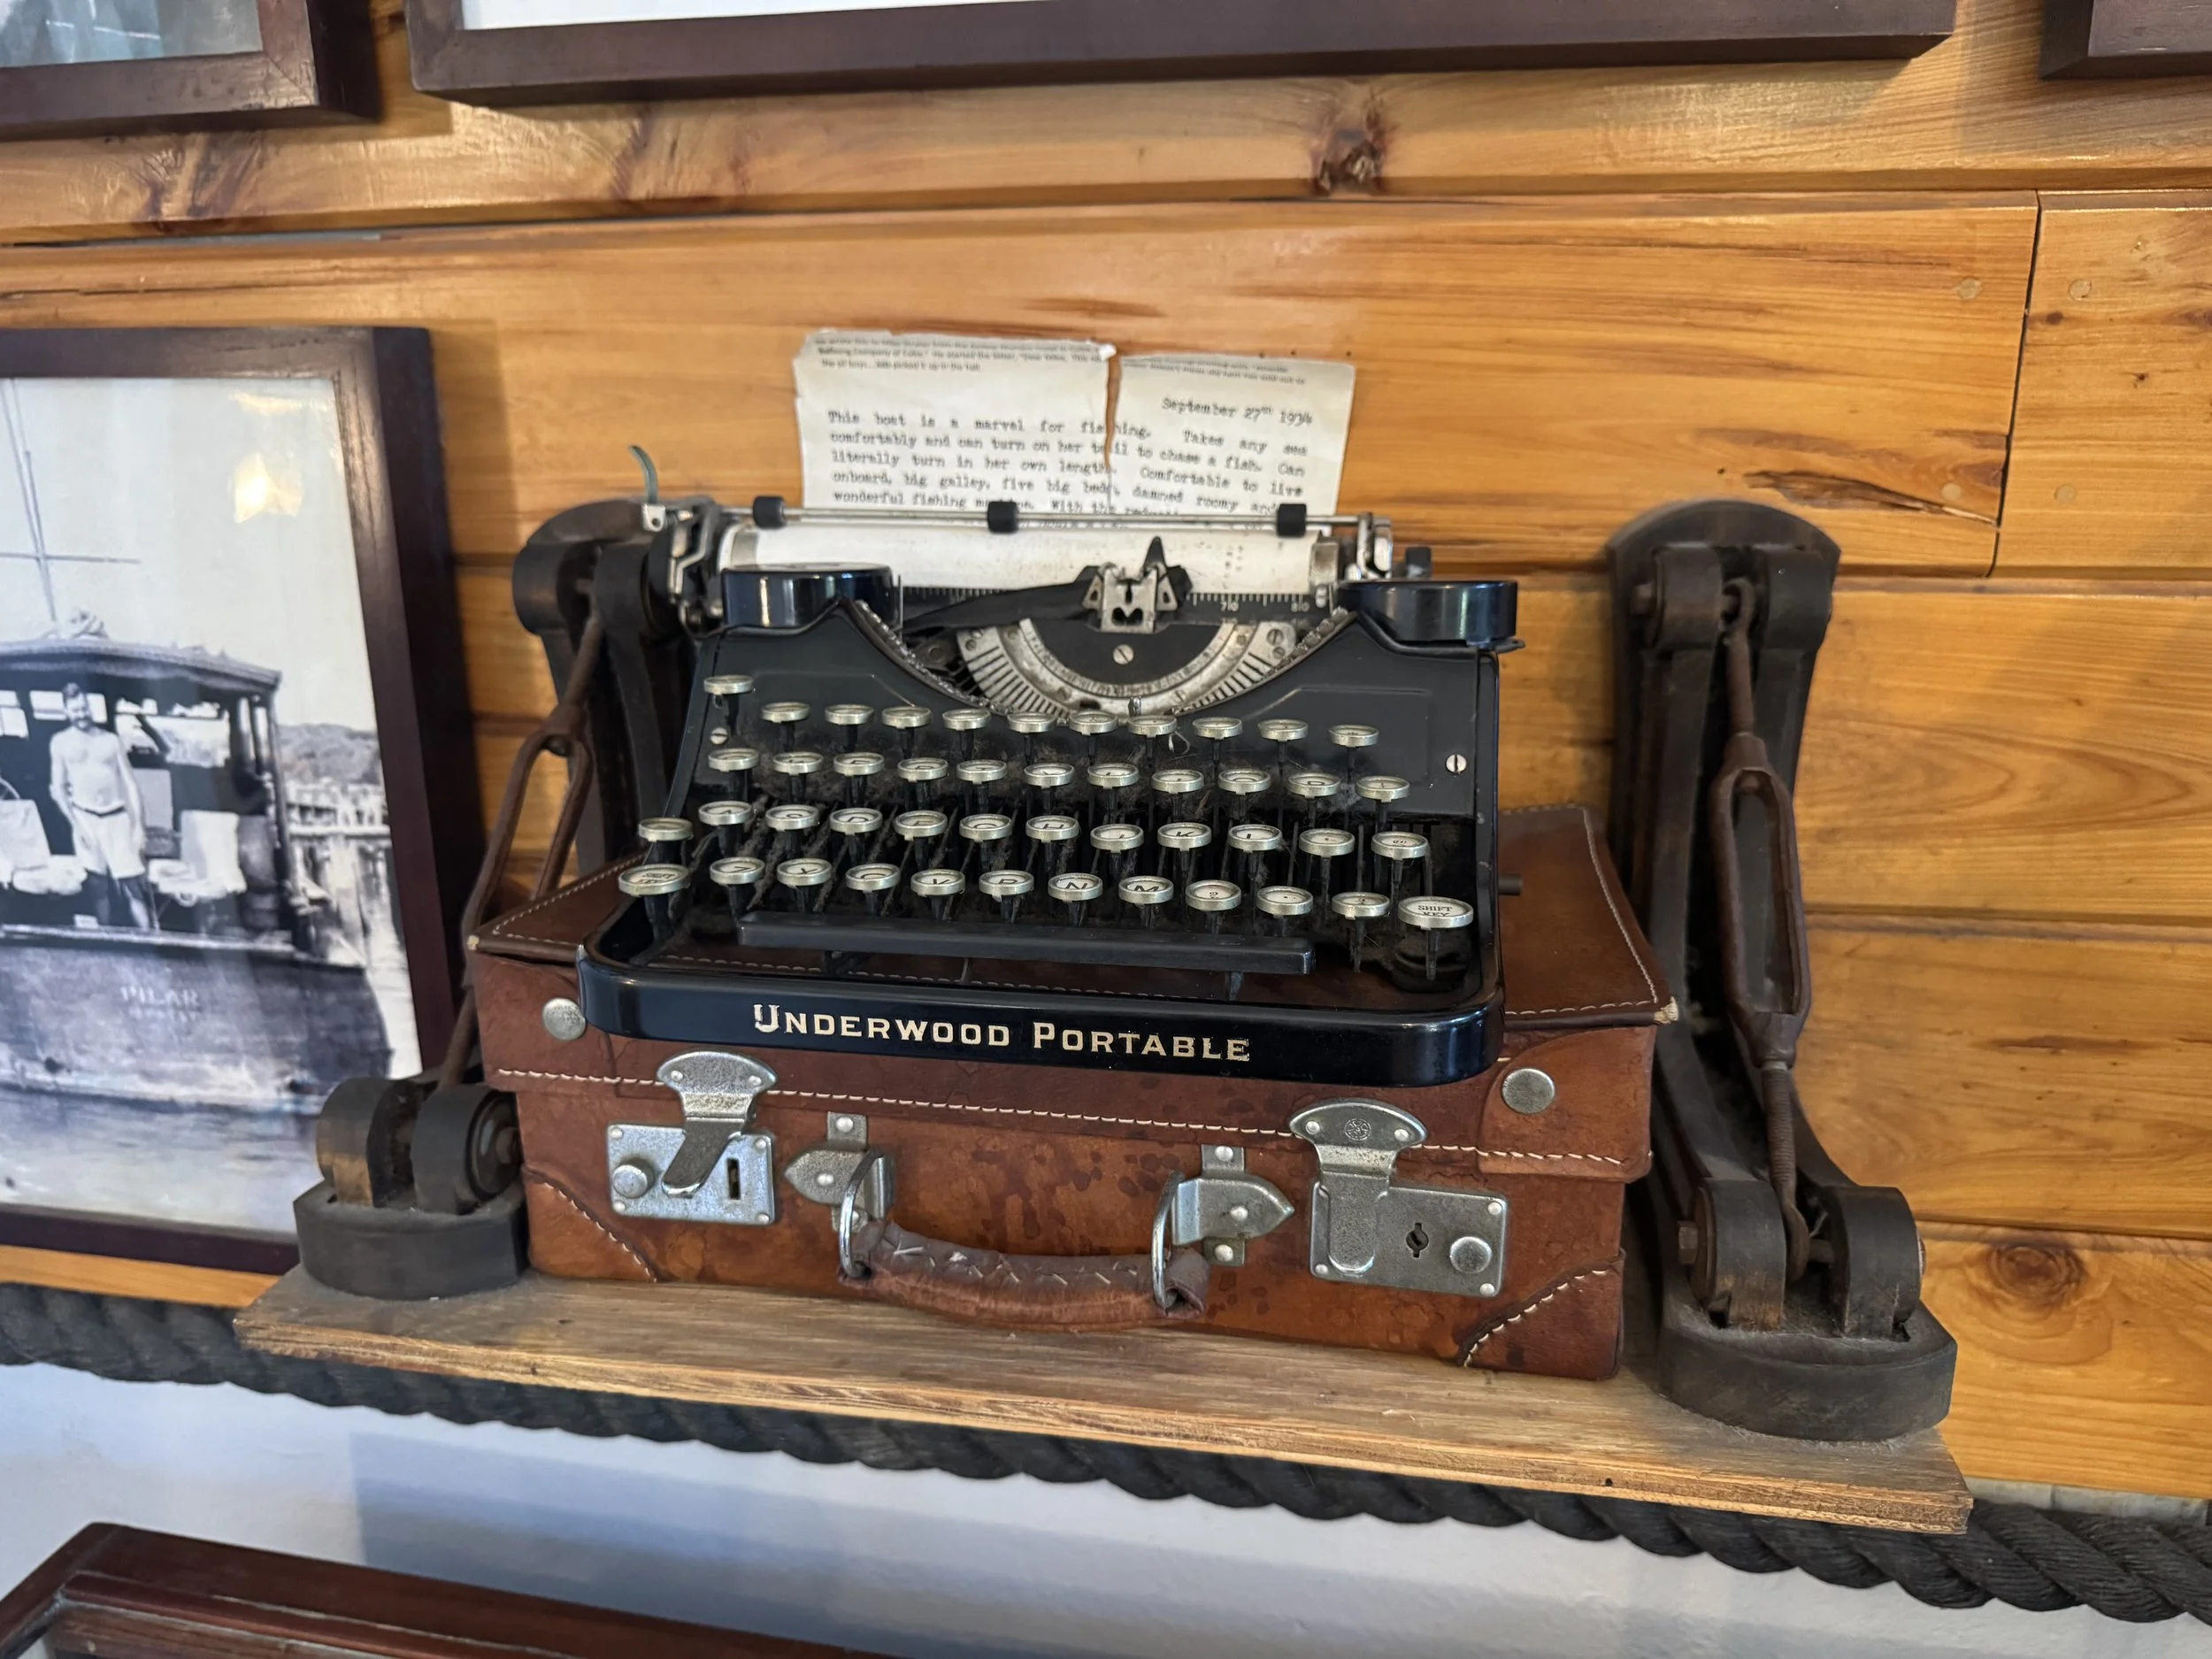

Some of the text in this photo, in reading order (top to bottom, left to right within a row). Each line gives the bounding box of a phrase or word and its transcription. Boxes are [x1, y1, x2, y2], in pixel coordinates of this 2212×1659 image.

[1162, 398, 1236, 419] September
[828, 410, 859, 424] This
[874, 411, 906, 426] boat
[921, 414, 935, 427] is
[950, 418, 959, 428] a
[975, 419, 1025, 432] marvel
[1040, 419, 1065, 433] for
[1182, 429, 1225, 447] Takes
[1239, 440, 1267, 455] any
[1283, 444, 1307, 457] sea
[830, 431, 917, 449] comfortably
[925, 434, 950, 448] and
[958, 438, 983, 449] can
[992, 435, 1025, 451] turn
[1032, 441, 1050, 452] on
[1058, 441, 1083, 454] her
[1137, 444, 1153, 458] to
[1159, 449, 1201, 465] chase
[1207, 456, 1217, 466] a
[1278, 463, 1305, 478] Can
[832, 449, 900, 467] literally
[911, 454, 945, 467] turn
[956, 455, 973, 469] in
[984, 457, 1010, 471] her
[1020, 461, 1047, 472] own
[1140, 466, 1231, 489] Comfortable
[1242, 479, 1259, 492] to
[1270, 480, 1303, 496] live
[903, 472, 927, 488] big
[1002, 477, 1034, 490] five
[1046, 479, 1071, 495] big
[1196, 495, 1239, 513] roomy
[833, 490, 904, 505] wonderful
[911, 492, 967, 511] fishing
[754, 1003, 1251, 1063] UNDERWOOD PORTABLE
